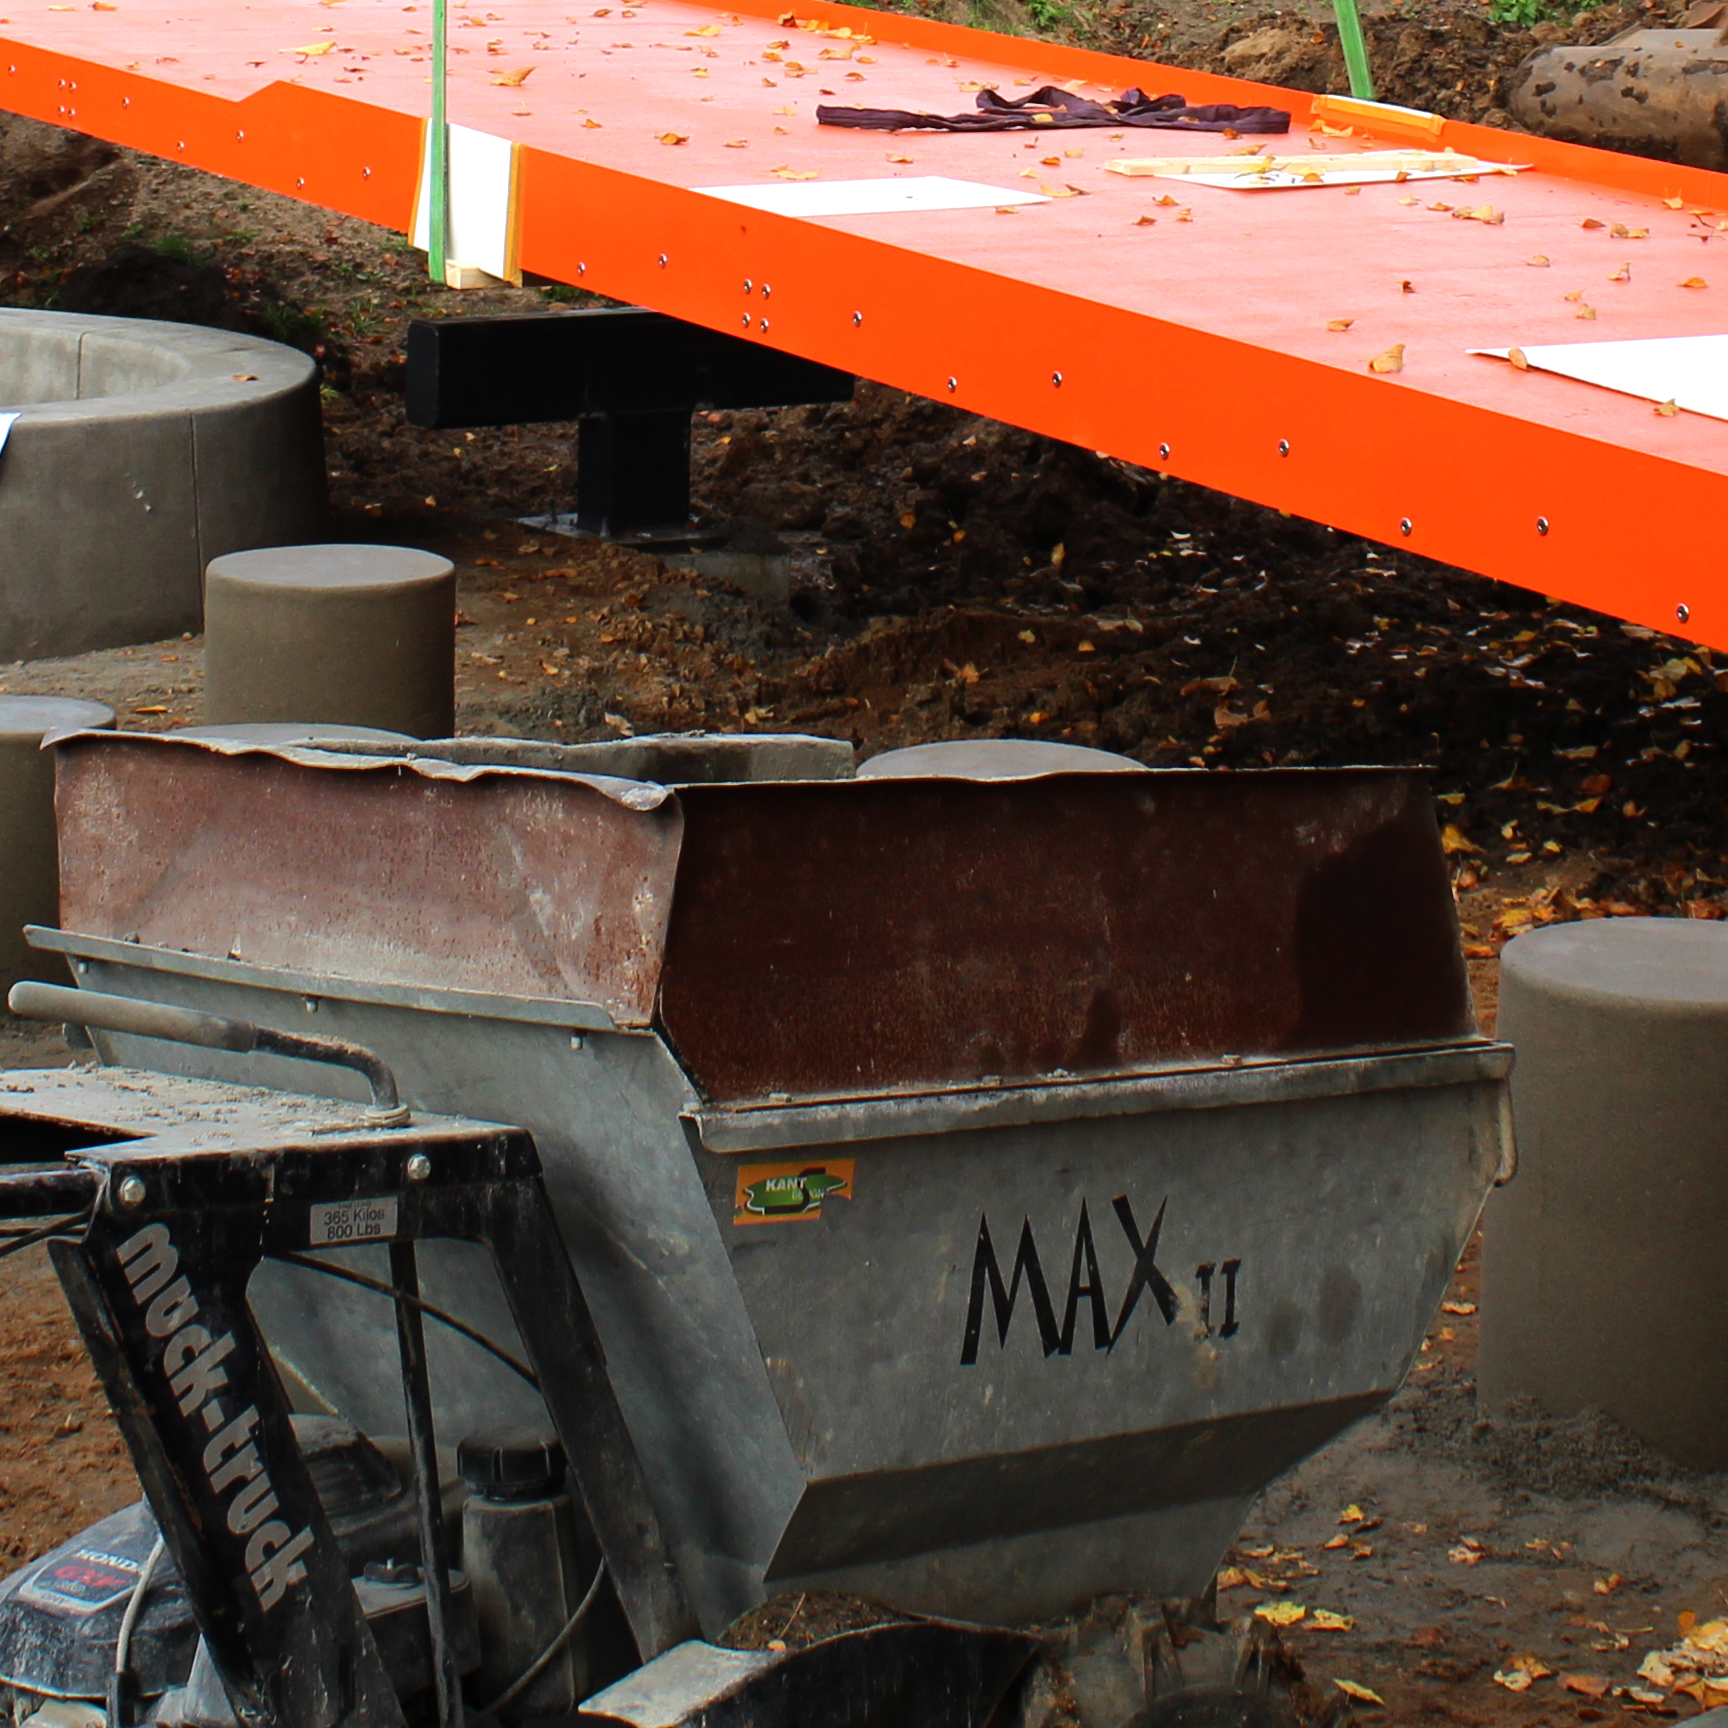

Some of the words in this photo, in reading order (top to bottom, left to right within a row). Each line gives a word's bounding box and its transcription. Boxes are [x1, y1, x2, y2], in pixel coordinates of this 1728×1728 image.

[765, 1176, 808, 1192] KANT
[323, 1210, 349, 1226] 365
[353, 1207, 385, 1223] Kilos
[327, 1224, 353, 1240] 800
[357, 1223, 381, 1237] Lbs
[960, 1194, 1179, 1366] MAX
[116, 1222, 315, 1612] muck-truck
[74, 1548, 146, 1576] HOND
